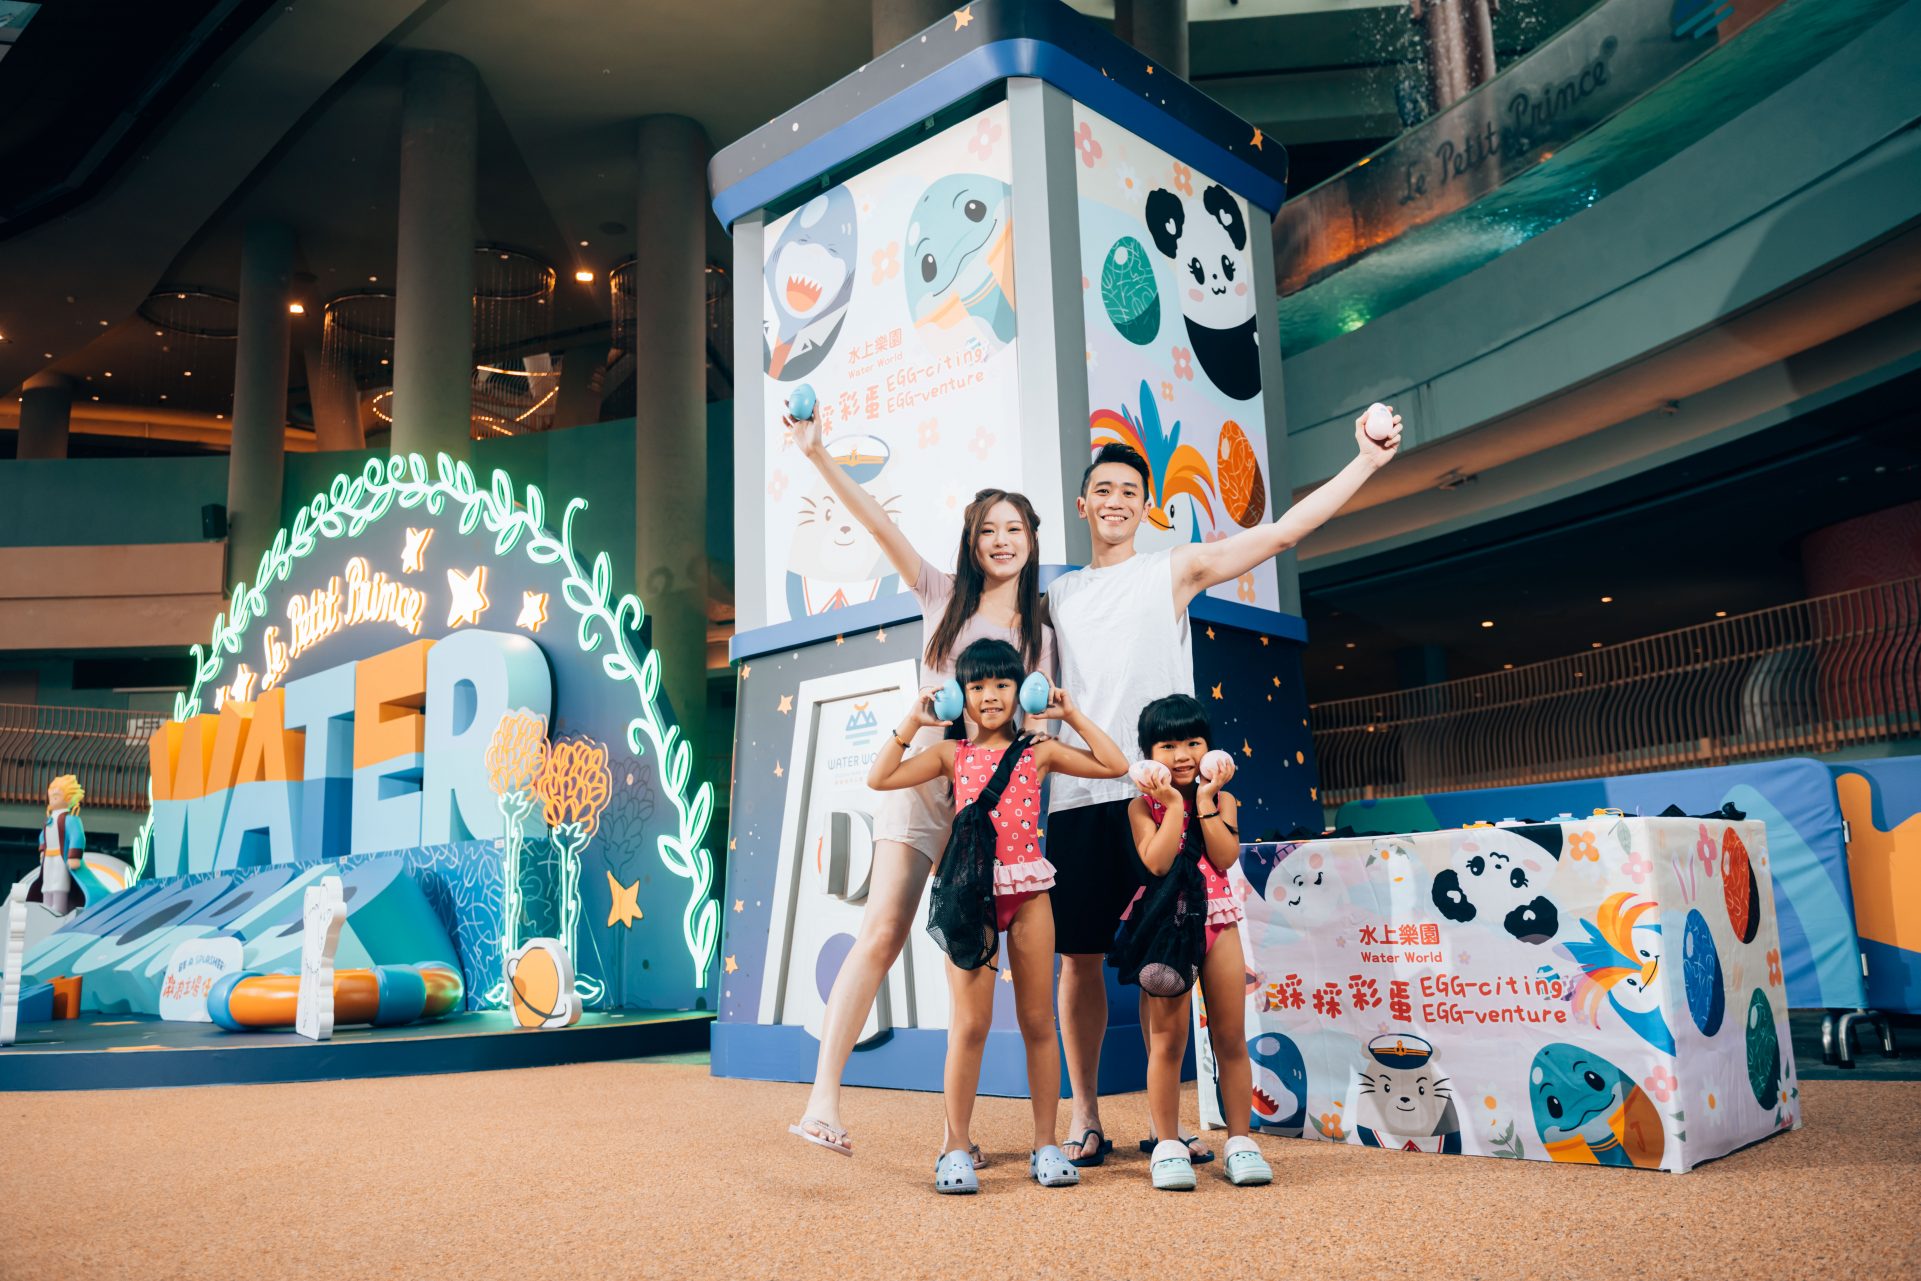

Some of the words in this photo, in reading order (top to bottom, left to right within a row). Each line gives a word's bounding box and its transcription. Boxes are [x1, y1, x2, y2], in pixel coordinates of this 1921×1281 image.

[1399, 161, 1428, 206] Le
[1436, 121, 1498, 186] Petit
[848, 328, 903, 364] 水上樂園
[848, 364, 874, 380] Water
[877, 351, 904, 369] World
[886, 347, 983, 393] EGG-citing
[886, 370, 985, 415] EGG-venture
[262, 625, 290, 690] Le
[287, 575, 343, 659] Petit
[344, 556, 426, 635] Prince
[149, 629, 535, 879] WATER
[828, 755, 859, 770] WATER
[1359, 922, 1440, 946] 水上樂園
[1360, 951, 1400, 964] Water
[1404, 950, 1443, 964] World
[1276, 973, 1412, 1023] 採採彩蛋
[1420, 973, 1563, 1000] EGG-citing
[1422, 1001, 1567, 1024] EGG-venture
